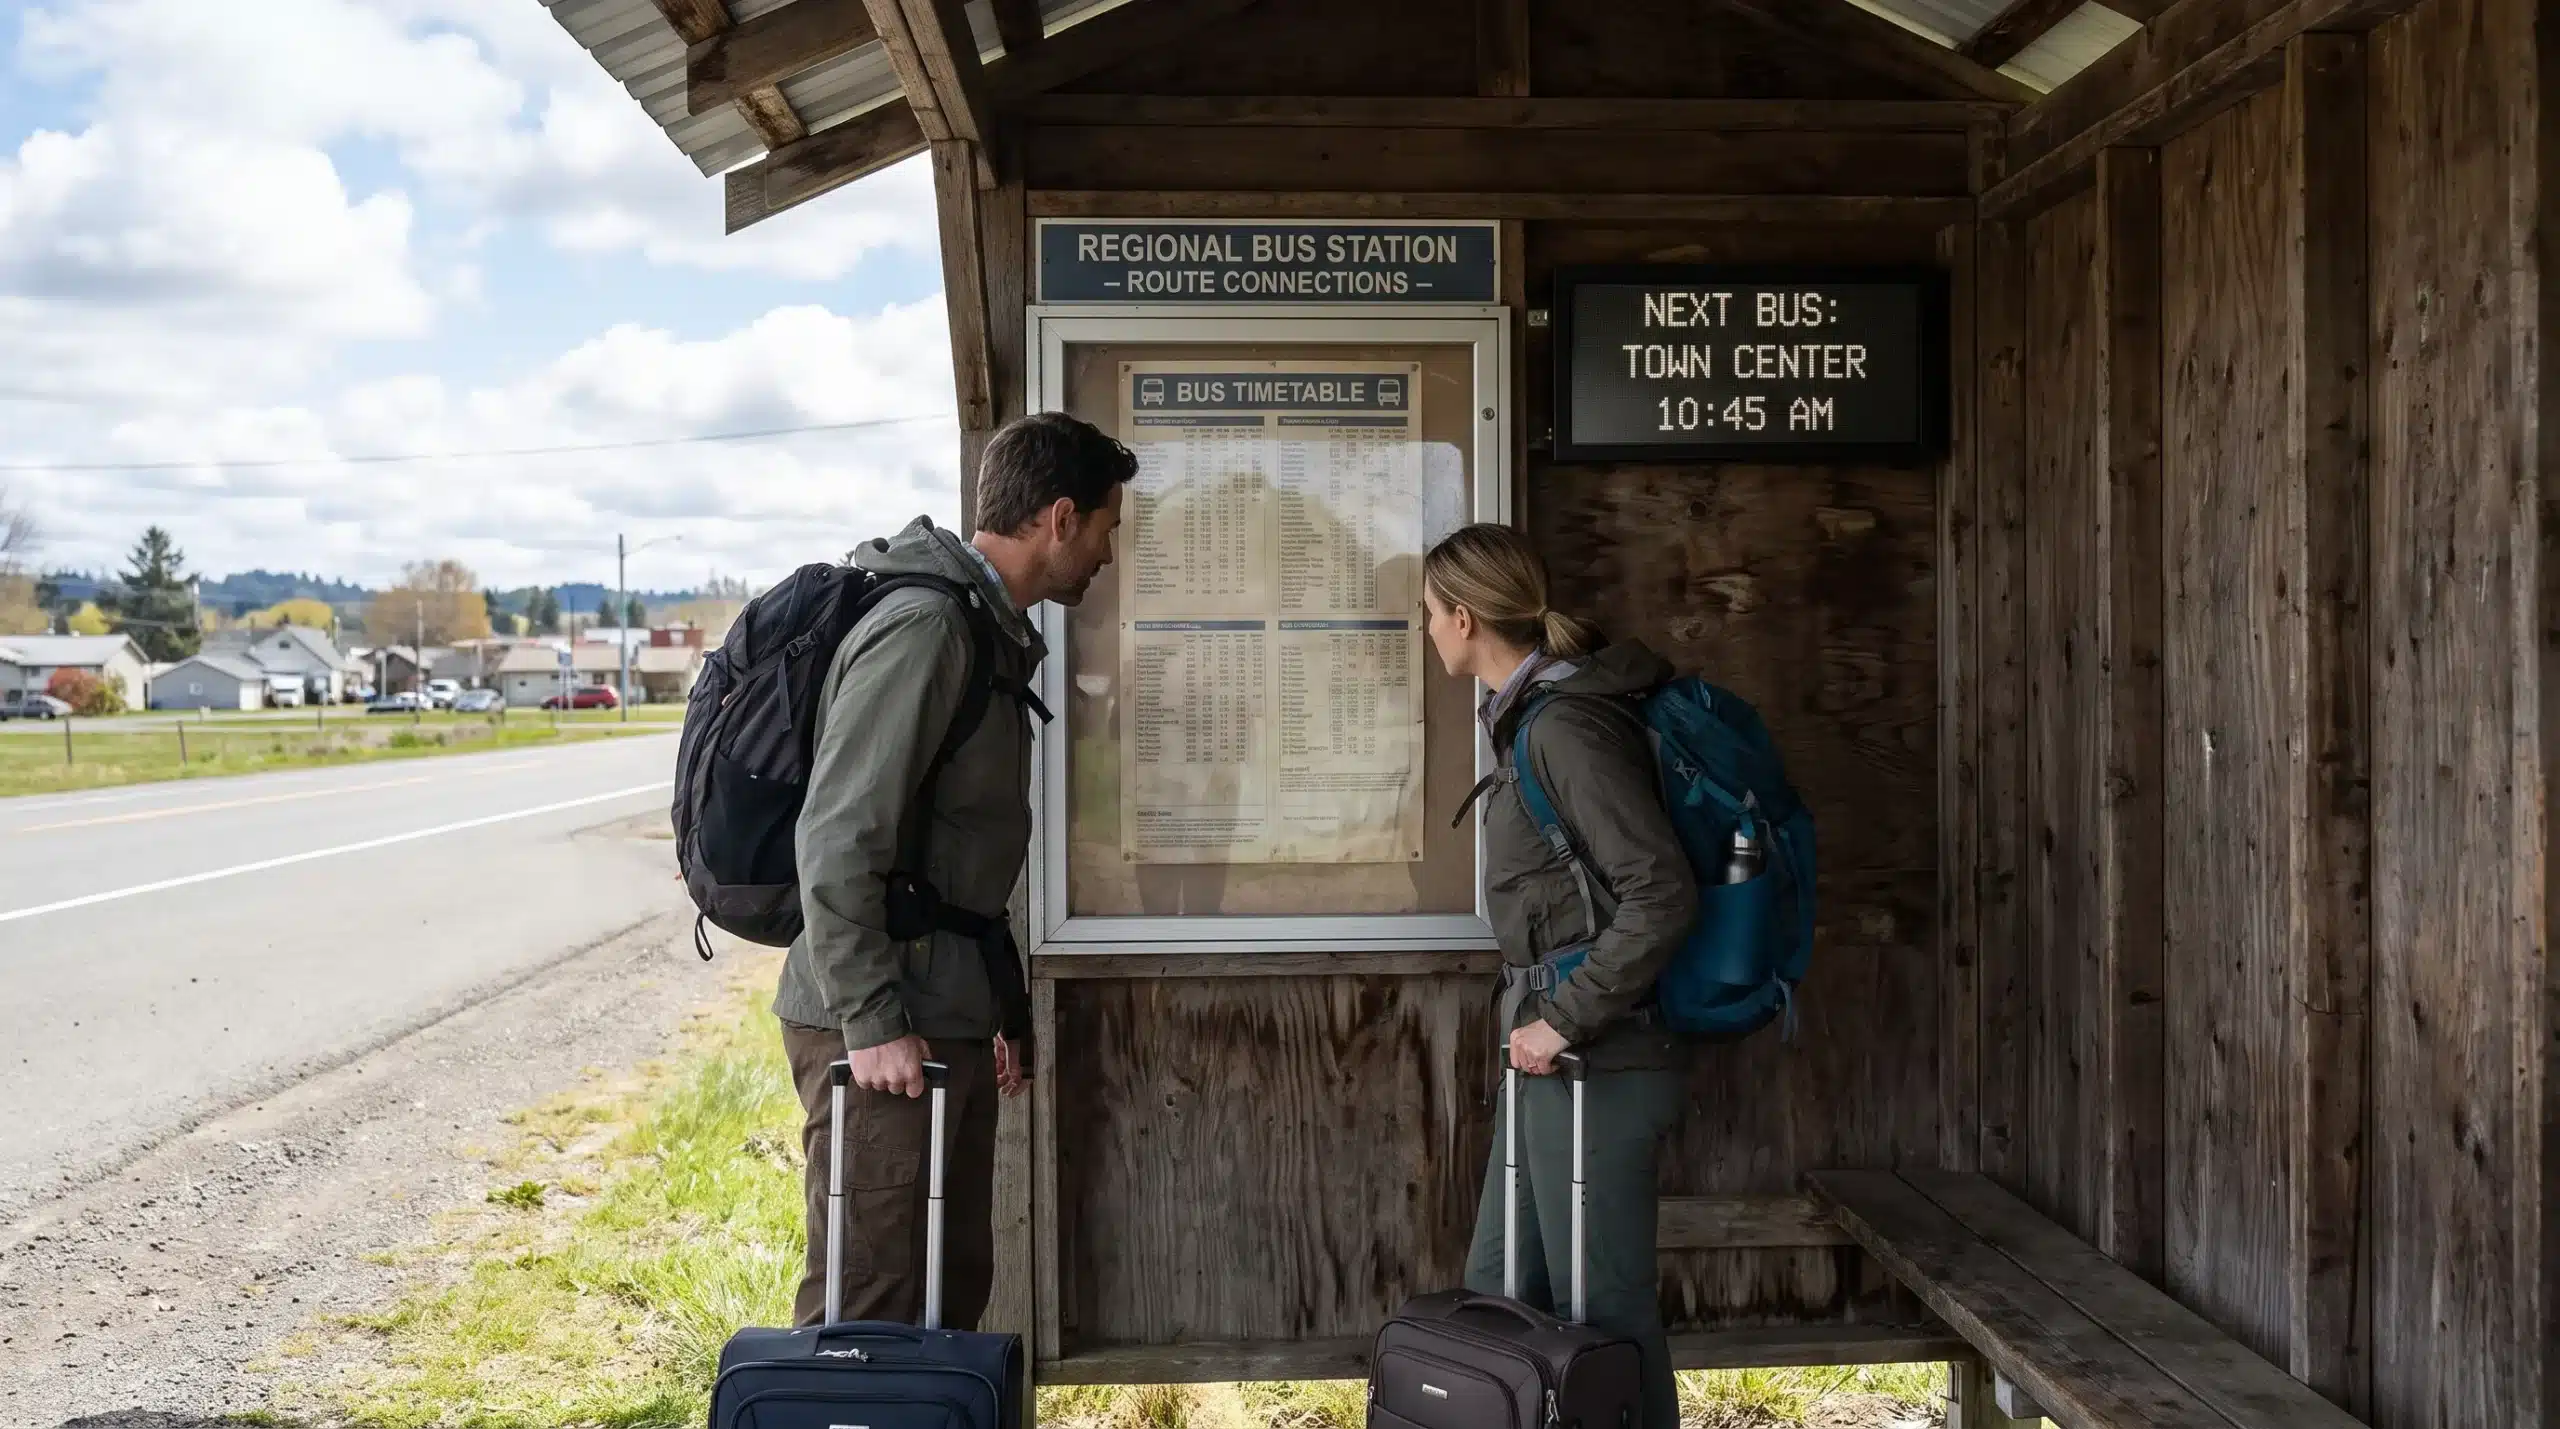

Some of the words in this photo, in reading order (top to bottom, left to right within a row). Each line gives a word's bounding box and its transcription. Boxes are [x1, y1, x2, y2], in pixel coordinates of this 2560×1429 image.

[1078, 233, 1243, 262] REGIONAL
[1252, 234, 1316, 263] BUS
[1326, 234, 1457, 263] STATION
[1127, 270, 1215, 293] ROUTE
[1223, 270, 1409, 294] CONNECTIONS
[1644, 292, 1733, 327] NEXT
[1756, 292, 1837, 327] BUS:
[1622, 344, 1711, 379] TOWN
[1734, 344, 1867, 379] CENTER
[1177, 381, 1226, 403] BUS
[1232, 381, 1365, 403] TIMETABLE
[1658, 395, 1766, 431] 10:45
[1789, 396, 1834, 431] AM
